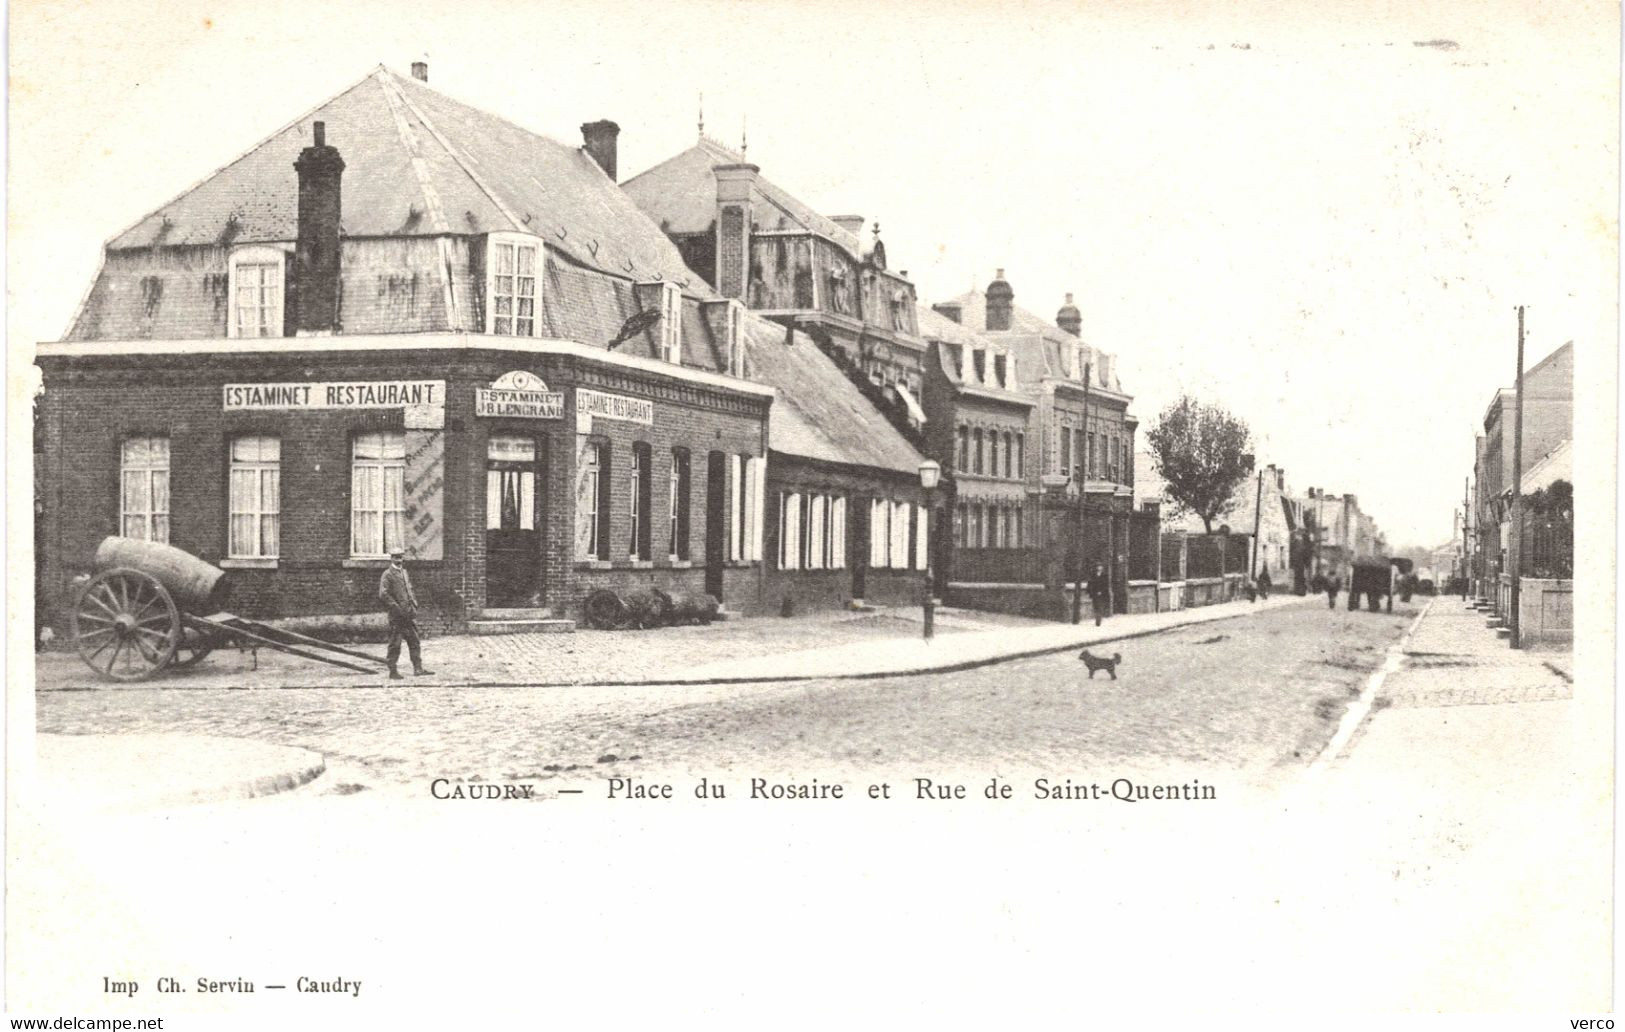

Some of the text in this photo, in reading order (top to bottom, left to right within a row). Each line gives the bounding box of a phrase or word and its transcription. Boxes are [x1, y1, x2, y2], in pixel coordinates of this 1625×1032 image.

[226, 384, 435, 406] ESTAMINET RESTAURANT
[481, 391, 562, 403] ESTAMINET
[497, 403, 563, 417] LENGRAND
[578, 391, 652, 422] ESTAMINET RESTAURANT
